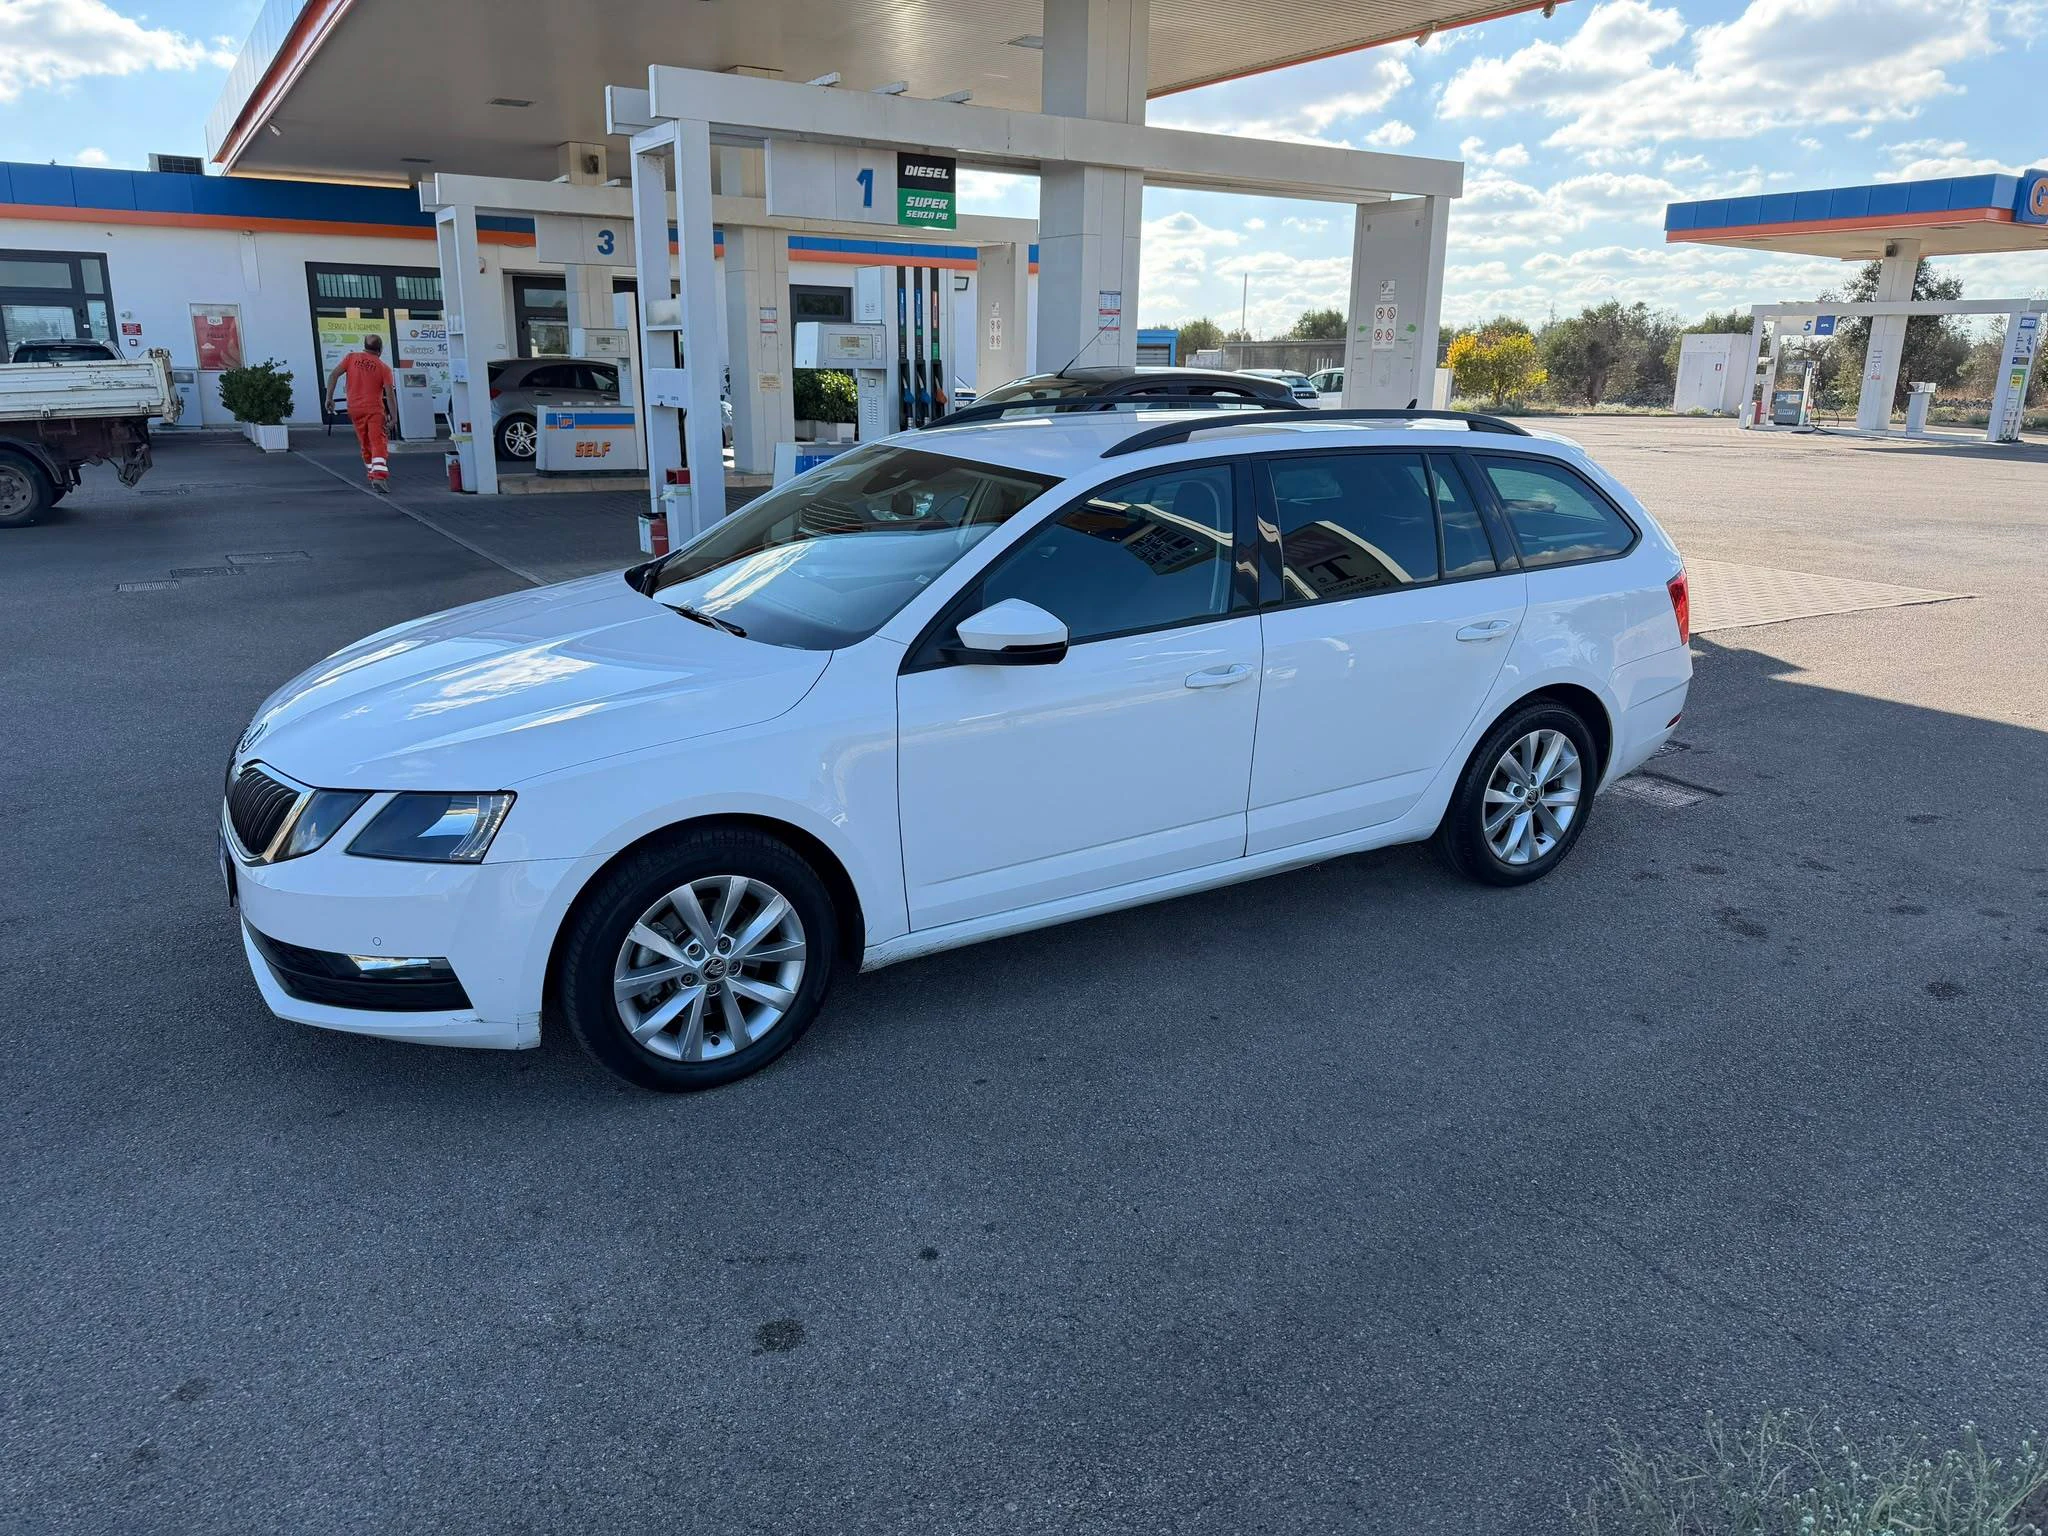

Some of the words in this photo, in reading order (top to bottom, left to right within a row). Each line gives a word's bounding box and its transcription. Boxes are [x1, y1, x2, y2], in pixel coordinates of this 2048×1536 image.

[904, 165, 949, 179] DIESEL
[856, 168, 873, 208] 1
[906, 196, 949, 209] SUPER
[906, 210, 934, 218] SENZA
[936, 212, 948, 220] PB
[597, 229, 615, 255] 3
[1803, 320, 1812, 331] 5
[420, 330, 447, 338] SNA
[575, 441, 612, 458] SELF
